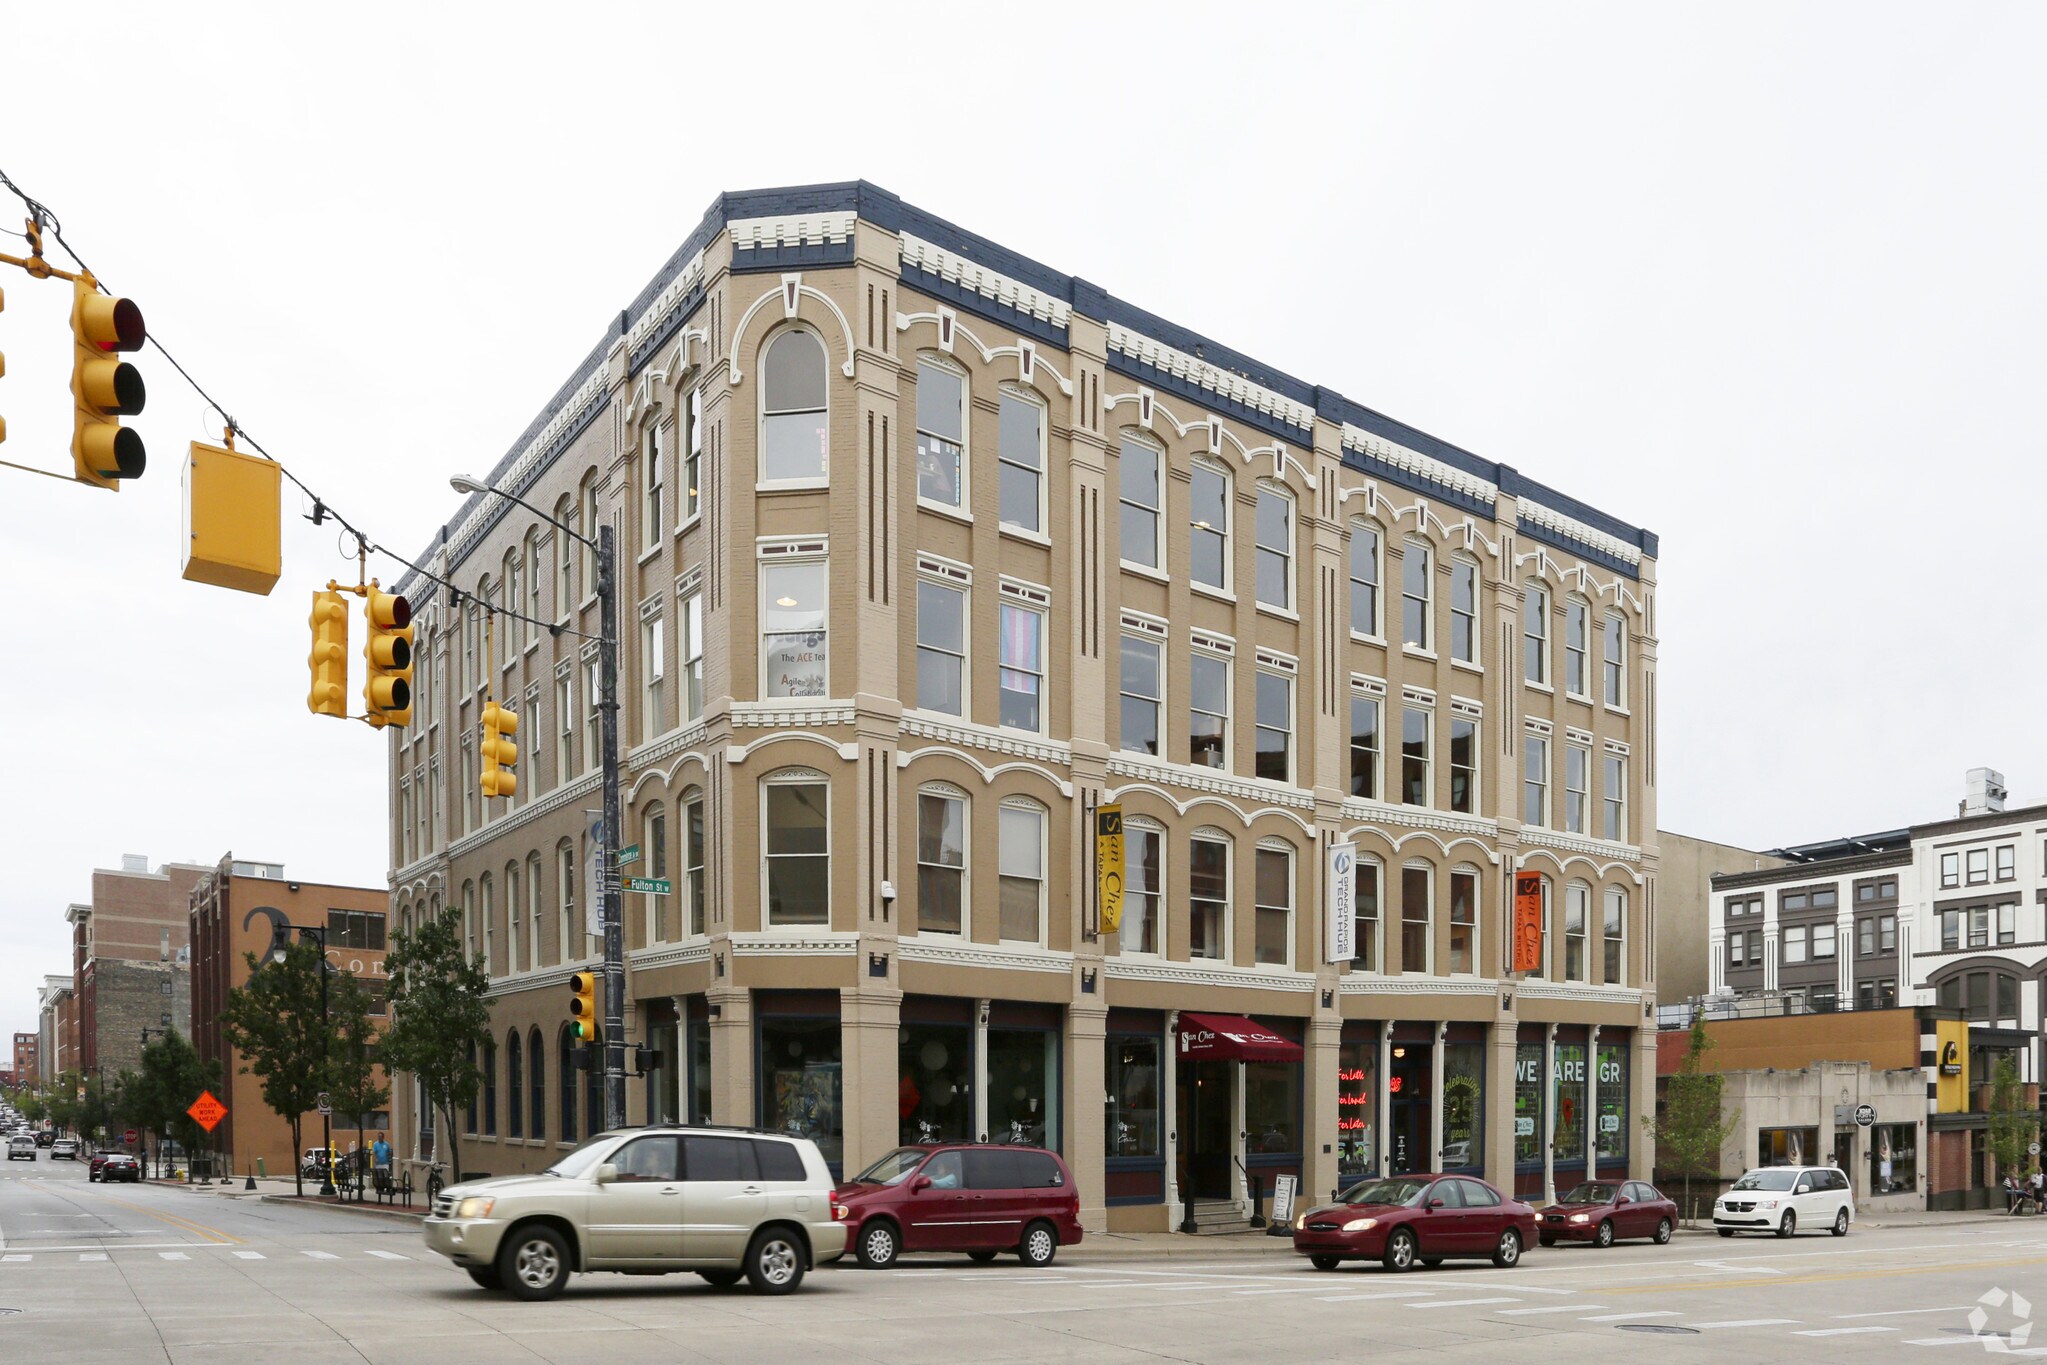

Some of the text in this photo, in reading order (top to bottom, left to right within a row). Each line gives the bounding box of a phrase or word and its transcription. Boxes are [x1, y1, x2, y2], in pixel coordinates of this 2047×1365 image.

[781, 653, 795, 662] The
[797, 652, 813, 662] ACE
[1105, 815, 1122, 926] San Chez
[595, 849, 605, 931] TECH HUB
[631, 879, 654, 891] Fulton
[656, 883, 663, 892] St
[1523, 880, 1539, 966] San Chez
[1182, 1031, 1215, 1044] San Chez
[1515, 1061, 1620, 1082] WE ARE GR
[1450, 1128, 1471, 1142] years
